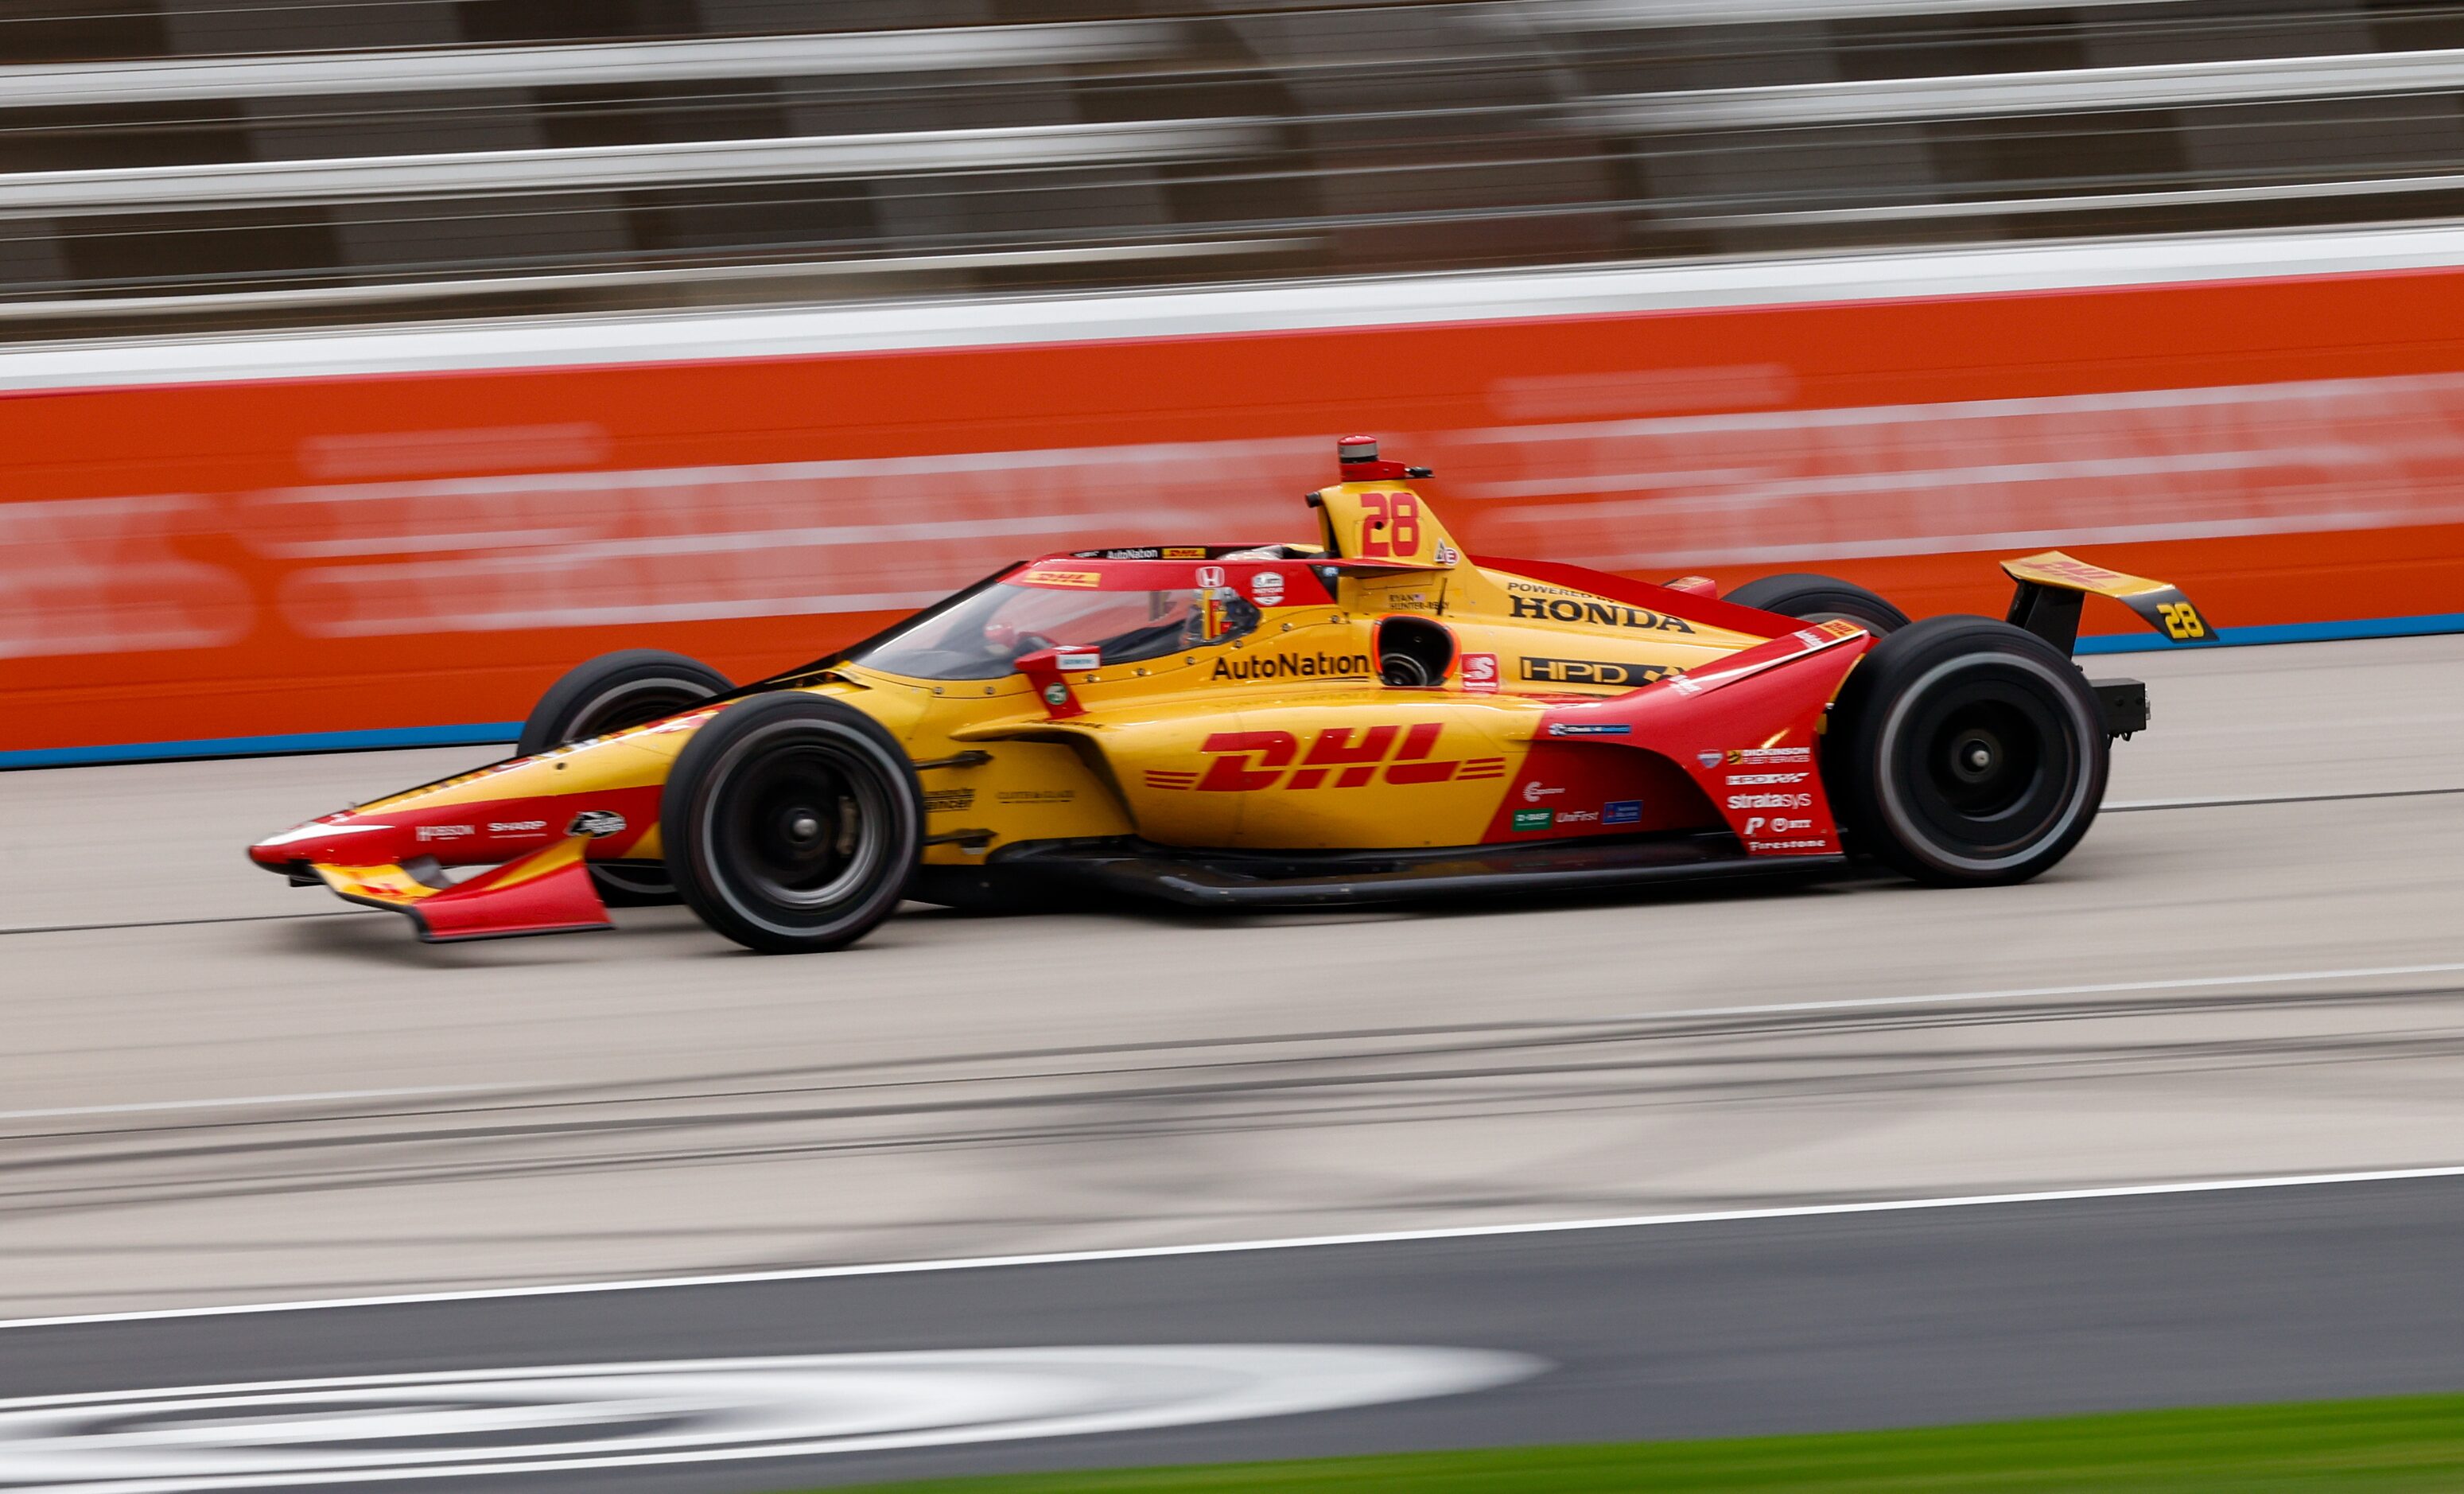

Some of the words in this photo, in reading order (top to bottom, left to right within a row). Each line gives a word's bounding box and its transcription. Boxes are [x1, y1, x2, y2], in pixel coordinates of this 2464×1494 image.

[1359, 492, 1420, 558] 28
[1106, 549, 1158, 560] AutoNation
[1508, 582, 1593, 598] POWERED
[1508, 593, 1696, 635] HONDA
[2155, 601, 2205, 639] 28
[1211, 652, 1370, 681] AutoNation
[1522, 659, 1630, 685] HPD
[1196, 722, 1461, 792] DHL
[1743, 747, 1811, 757] DICKINSON
[1727, 792, 1813, 810] stratasys
[1747, 839, 1827, 851] Firestone
